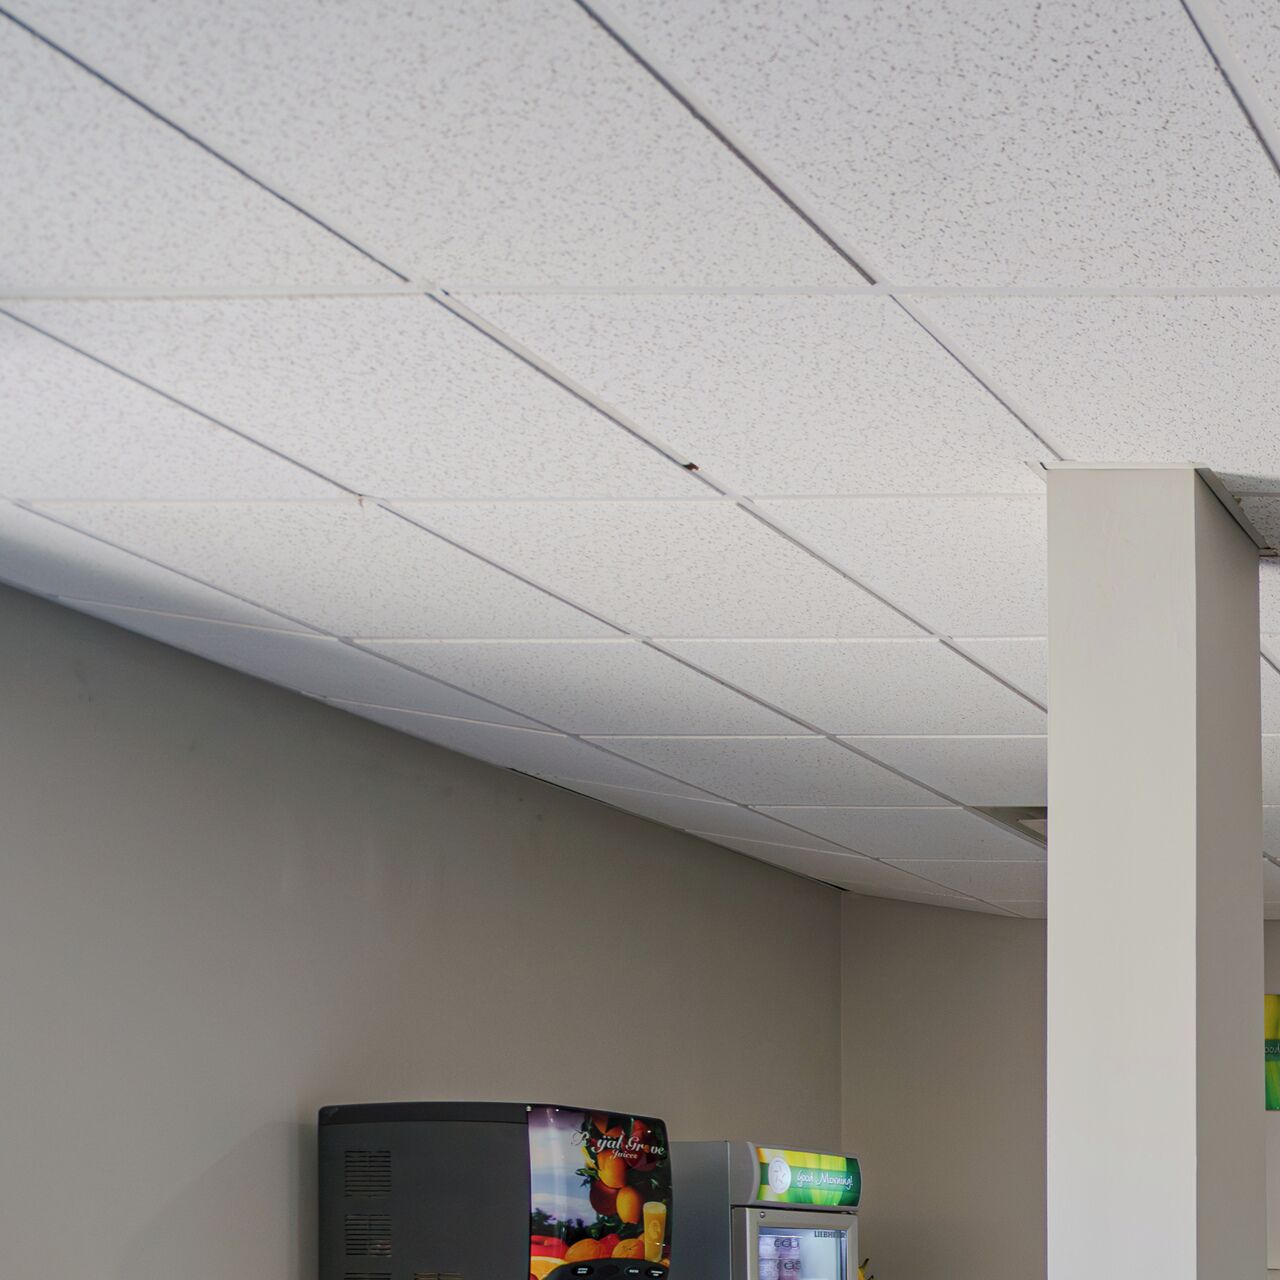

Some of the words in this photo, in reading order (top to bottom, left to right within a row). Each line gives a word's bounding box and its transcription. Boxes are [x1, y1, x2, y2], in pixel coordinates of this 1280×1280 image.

[1265, 1043, 1280, 1054] ood
[610, 1149, 638, 1160] Juices
[797, 1169, 814, 1187] Good
[816, 1172, 854, 1190] Morning!
